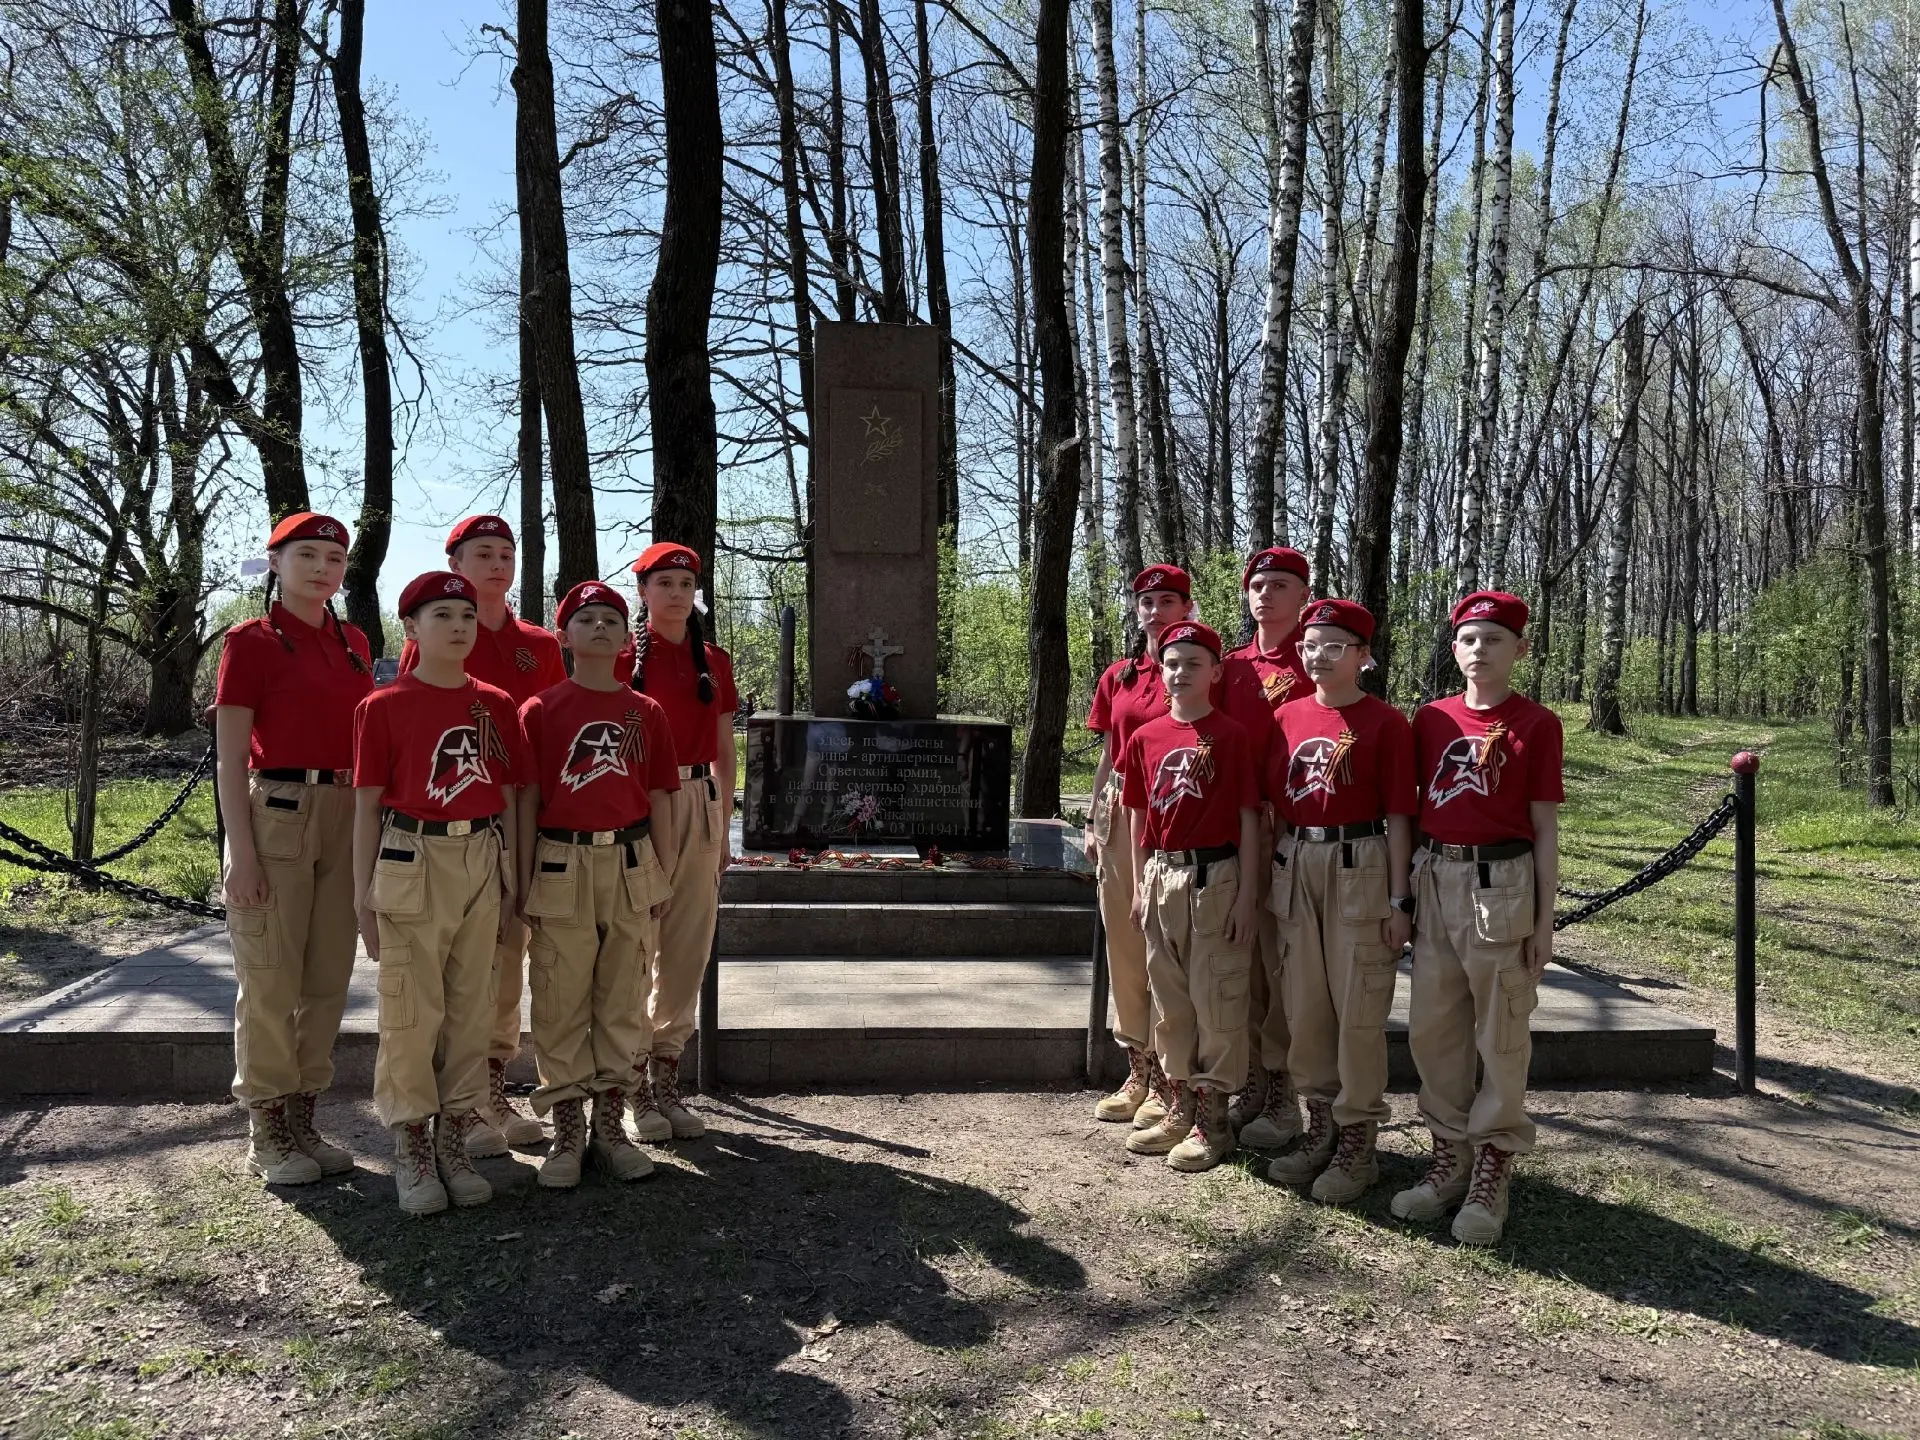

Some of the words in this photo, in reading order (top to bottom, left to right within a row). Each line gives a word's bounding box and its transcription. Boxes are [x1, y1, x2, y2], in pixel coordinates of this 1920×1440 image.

[863, 736, 944, 749] поронены
[807, 751, 848, 761] оины
[861, 752, 956, 766] артиллеристы
[818, 763, 888, 776] Советской
[896, 767, 943, 783] армии,
[847, 781, 905, 795] смертью
[768, 794, 777, 804] в
[889, 821, 959, 837] 0310.1941
